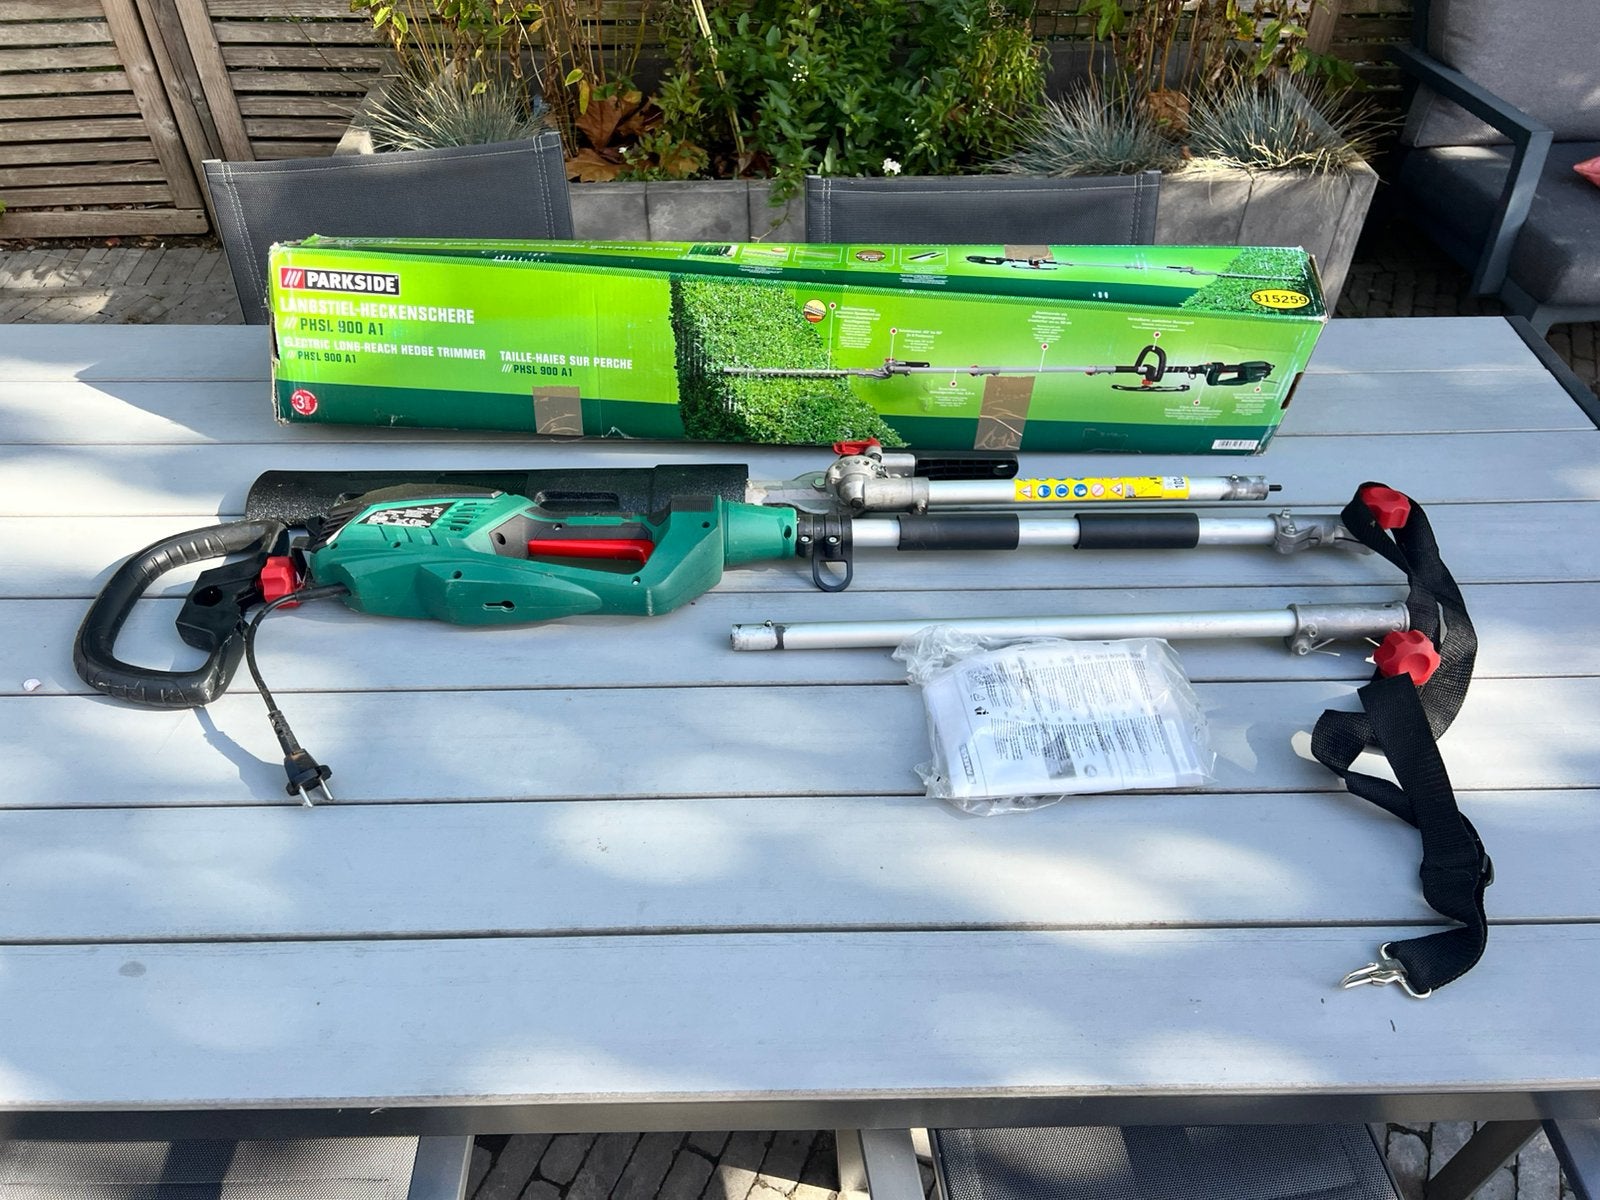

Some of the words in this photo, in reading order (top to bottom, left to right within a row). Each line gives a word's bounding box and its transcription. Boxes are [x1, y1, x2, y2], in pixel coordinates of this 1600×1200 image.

[307, 271, 396, 293] PARKSIDE
[1254, 294, 1308, 305] 315259
[280, 297, 475, 325] LANGSTIEL-HECKENSCHERE
[300, 317, 333, 332] PHSL
[338, 320, 363, 334] 900
[368, 322, 384, 336] A1
[284, 336, 330, 350] ELECTRIC
[334, 340, 398, 354] LONG-REACH
[401, 344, 434, 356] HEDGE
[437, 346, 486, 360] TRIMMER
[298, 350, 321, 361] PHSL
[324, 352, 342, 363] 900
[345, 354, 357, 364] A1
[499, 350, 566, 365] TAILLE-HAIES
[569, 355, 590, 367] SUR
[593, 357, 633, 370] PERCHE
[513, 364, 537, 375] PHSL
[540, 366, 558, 376] 900
[561, 367, 573, 377] A1
[295, 394, 305, 409] 3
